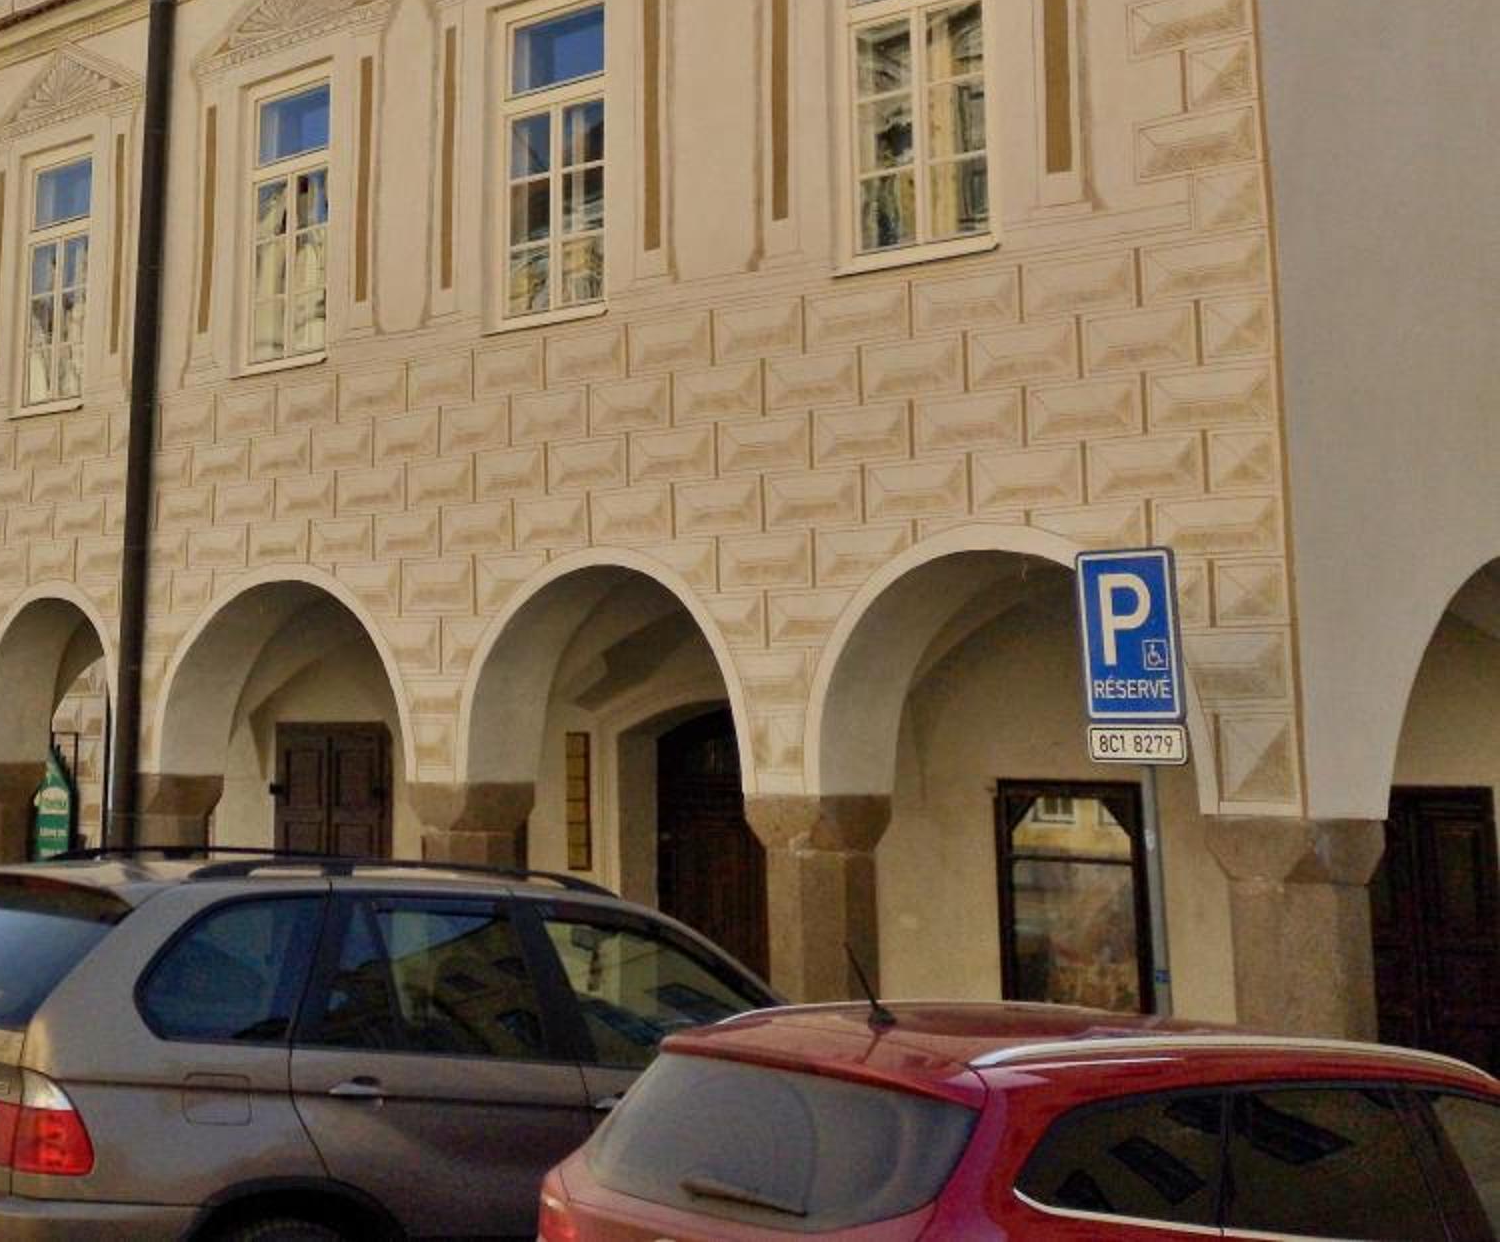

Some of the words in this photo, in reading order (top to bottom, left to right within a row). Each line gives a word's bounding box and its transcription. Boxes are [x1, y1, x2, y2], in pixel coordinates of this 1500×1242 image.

[1098, 572, 1151, 666] P
[1099, 734, 1125, 753] 8C1
[1133, 734, 1173, 753] 8279
